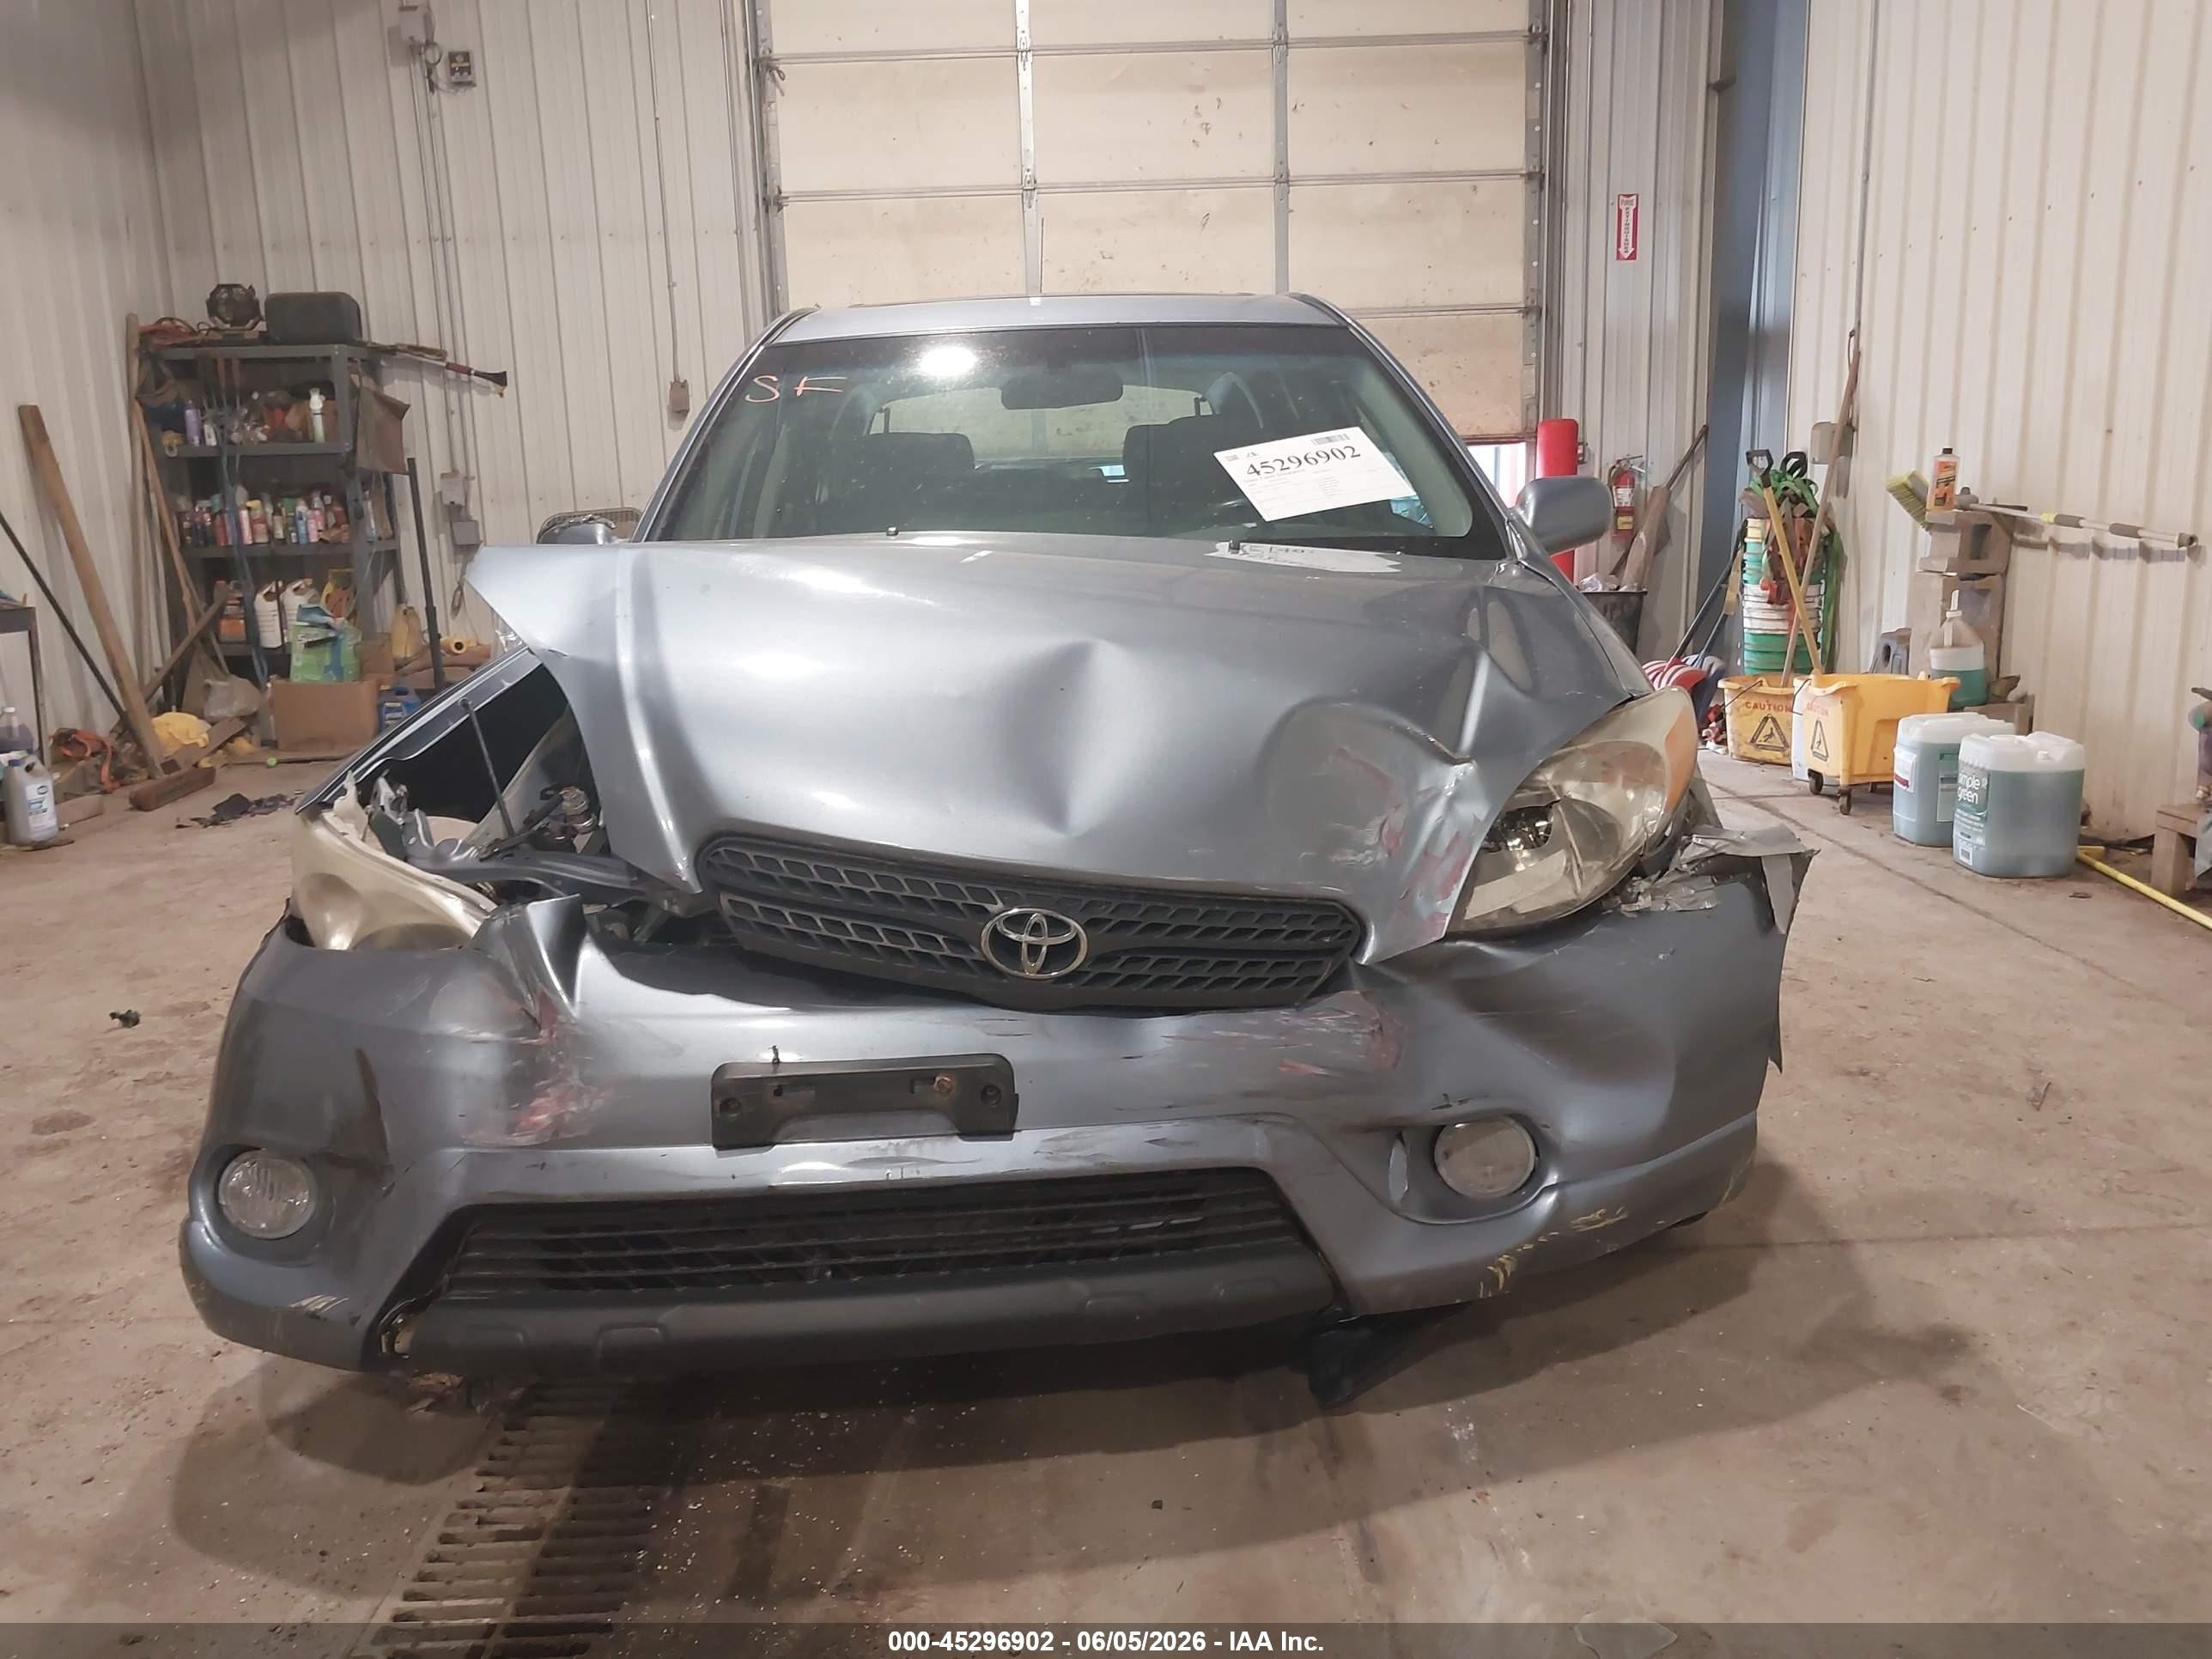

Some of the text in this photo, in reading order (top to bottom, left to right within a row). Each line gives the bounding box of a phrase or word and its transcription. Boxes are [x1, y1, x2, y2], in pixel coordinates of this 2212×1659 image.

[1246, 445, 1360, 477] 45296902
[1745, 701, 1792, 713] CAUTION
[1958, 786, 1978, 805] green
